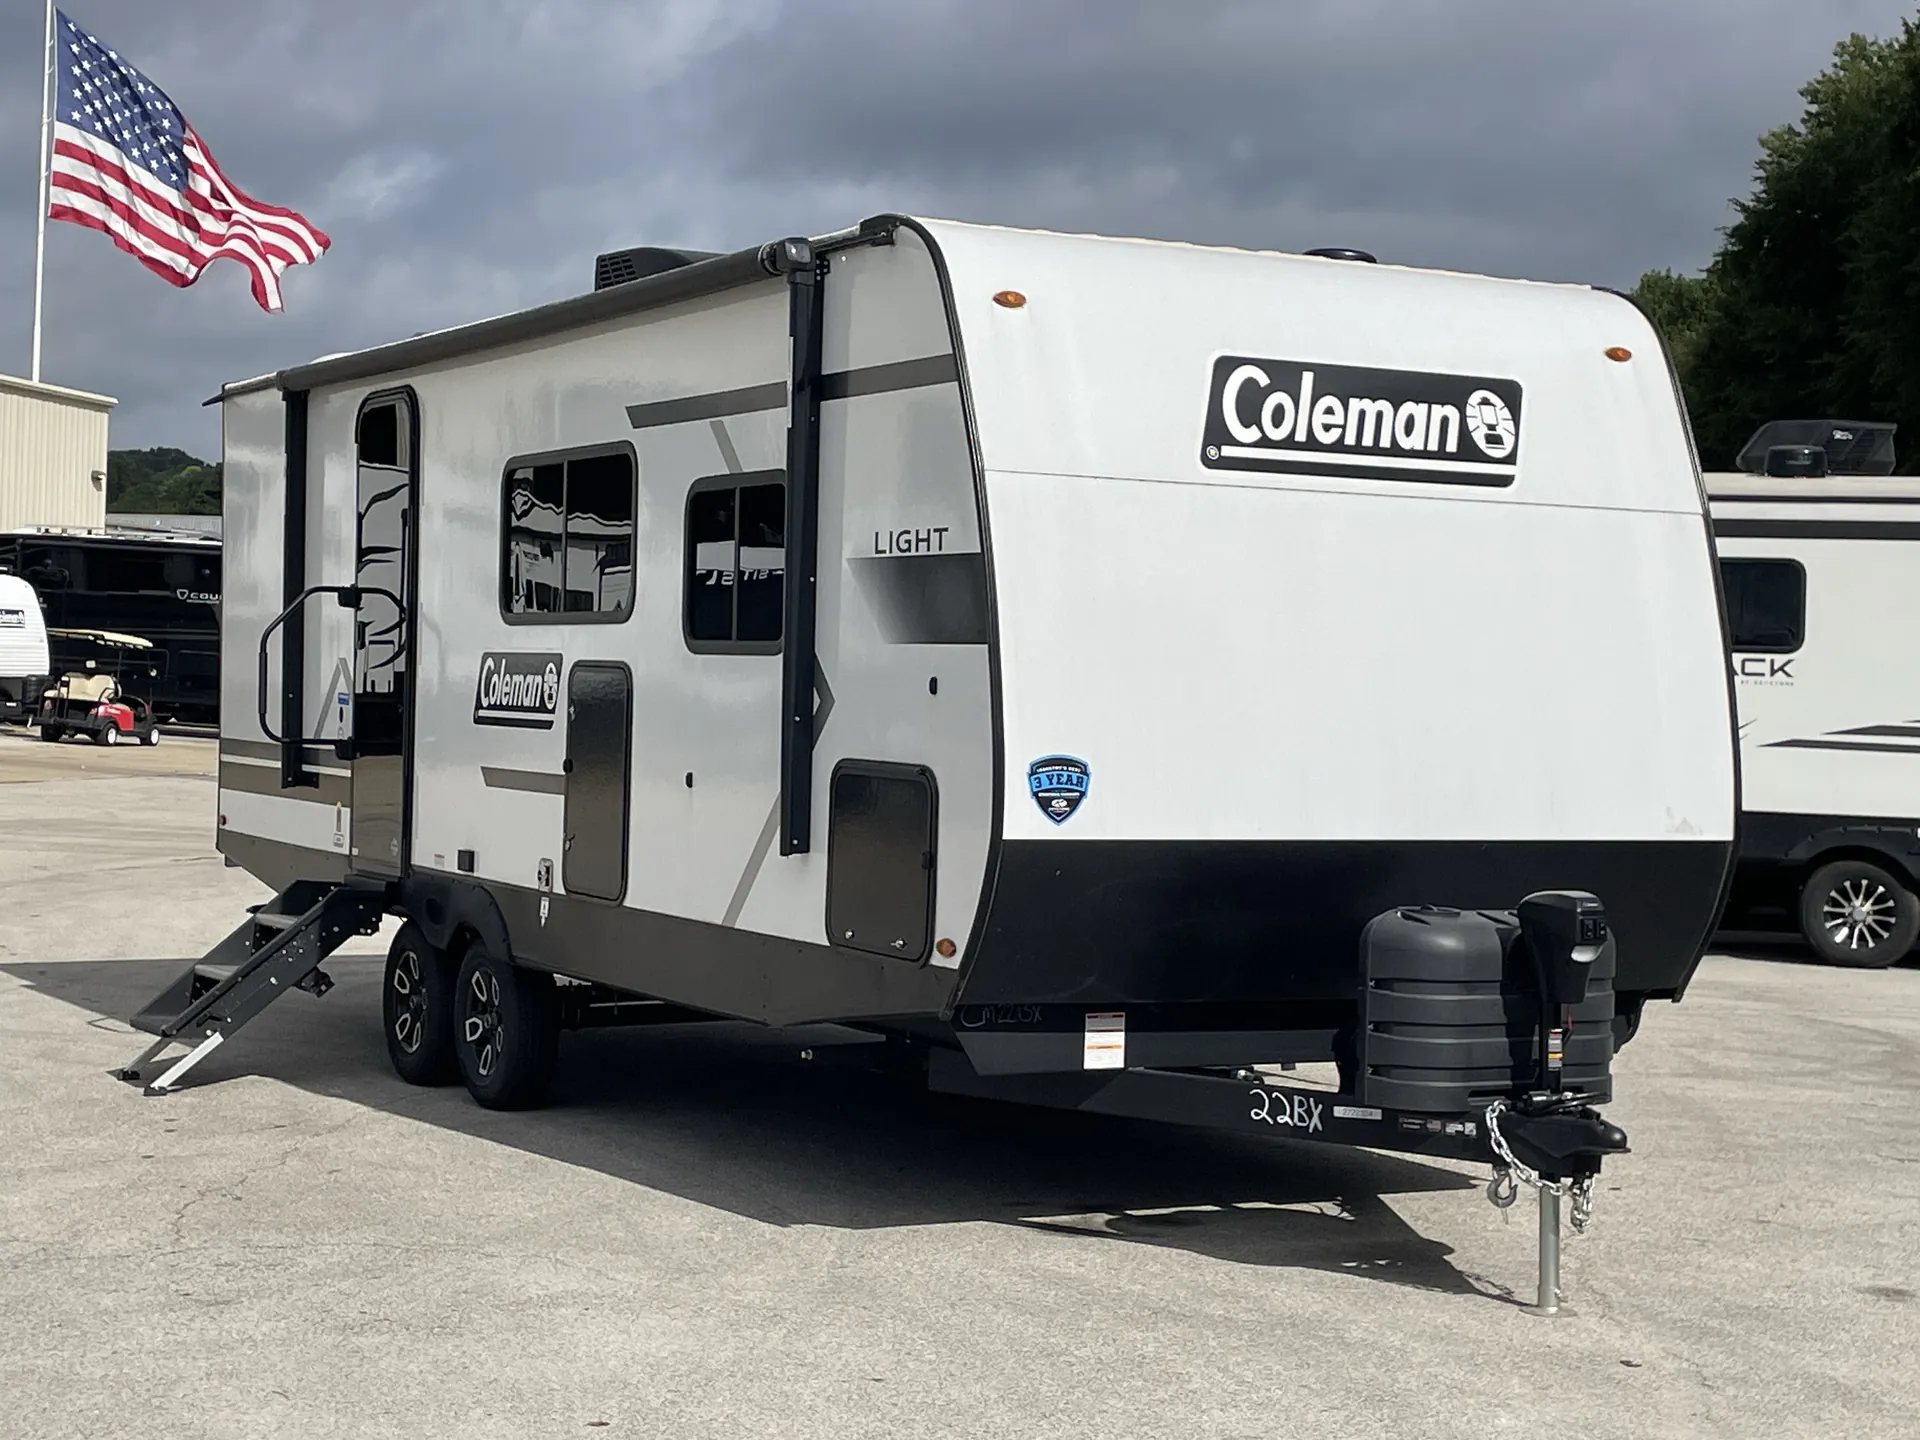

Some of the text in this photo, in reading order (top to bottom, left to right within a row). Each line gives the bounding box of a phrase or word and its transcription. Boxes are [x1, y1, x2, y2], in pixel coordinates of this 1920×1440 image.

[1220, 363, 1461, 453] Coleman
[874, 526, 950, 555] LIGHT
[190, 592, 222, 600] COU
[480, 656, 543, 708] Coleman
[1034, 773, 1085, 789] 3 YEAR
[1249, 1089, 1323, 1133] 22BX
